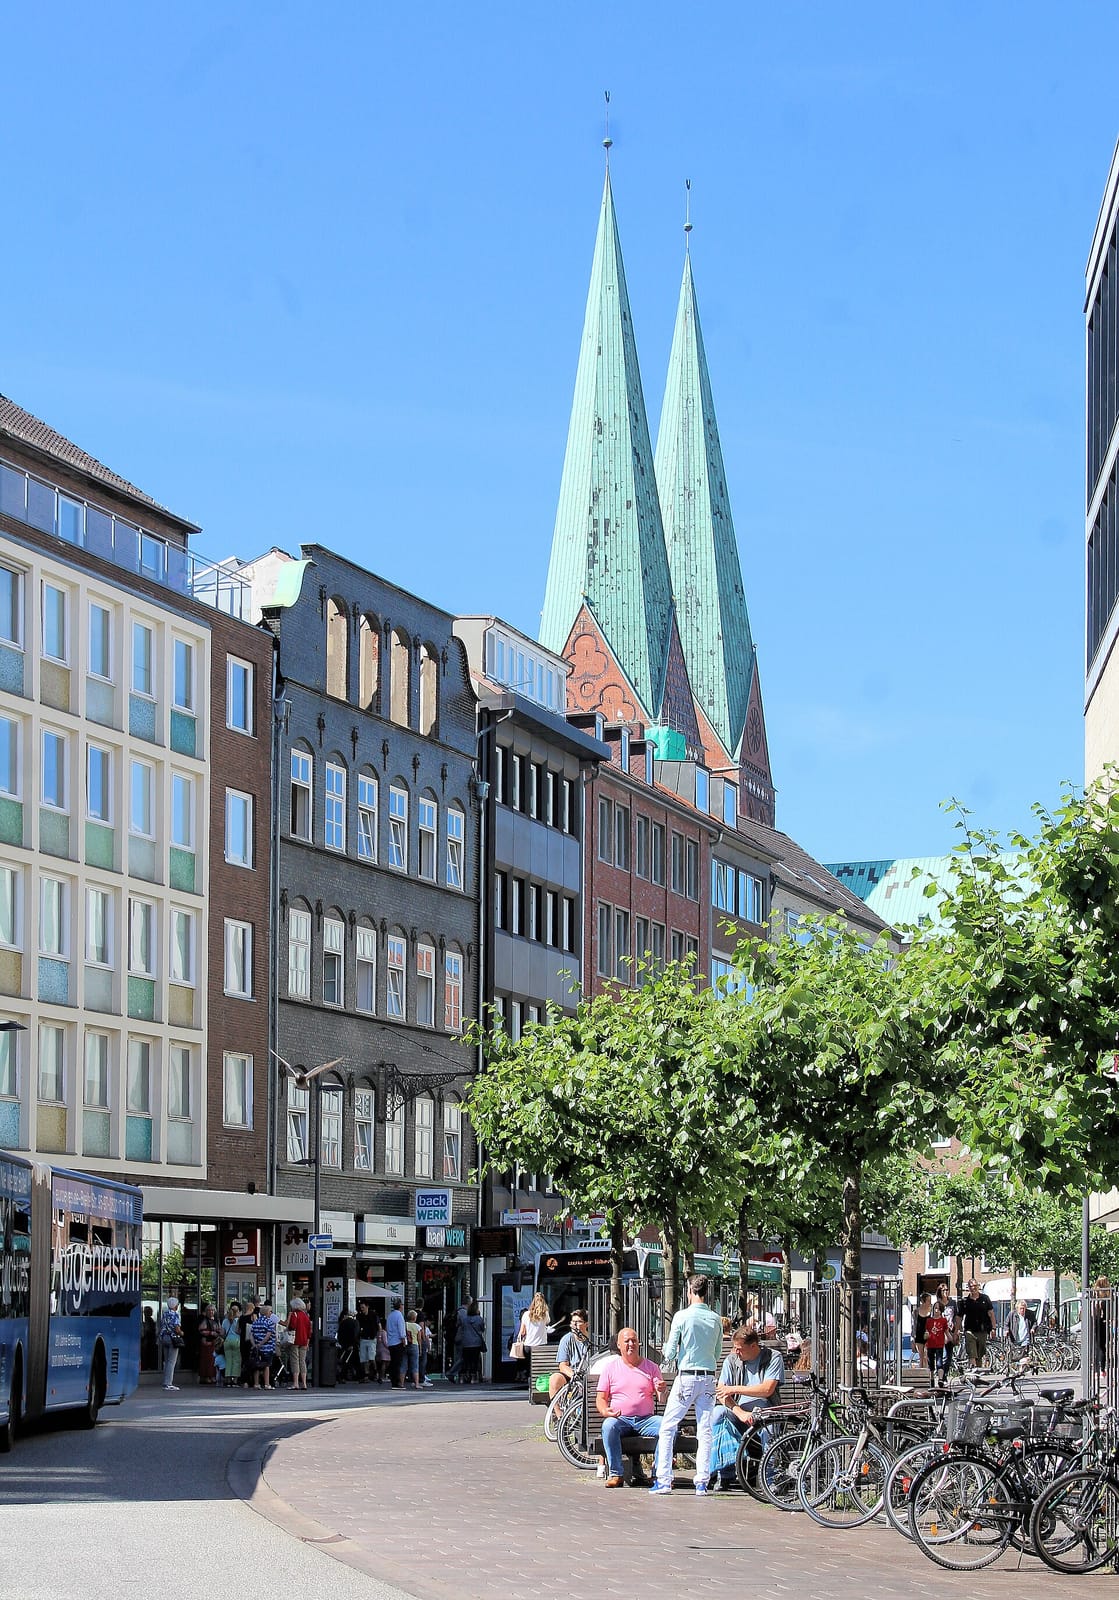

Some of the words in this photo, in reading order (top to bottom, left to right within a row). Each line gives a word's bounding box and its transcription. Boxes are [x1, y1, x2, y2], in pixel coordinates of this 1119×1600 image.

[419, 1195, 446, 1206] back
[417, 1209, 448, 1220] WERK
[427, 1227, 445, 1246] back
[445, 1229, 465, 1247] WERK
